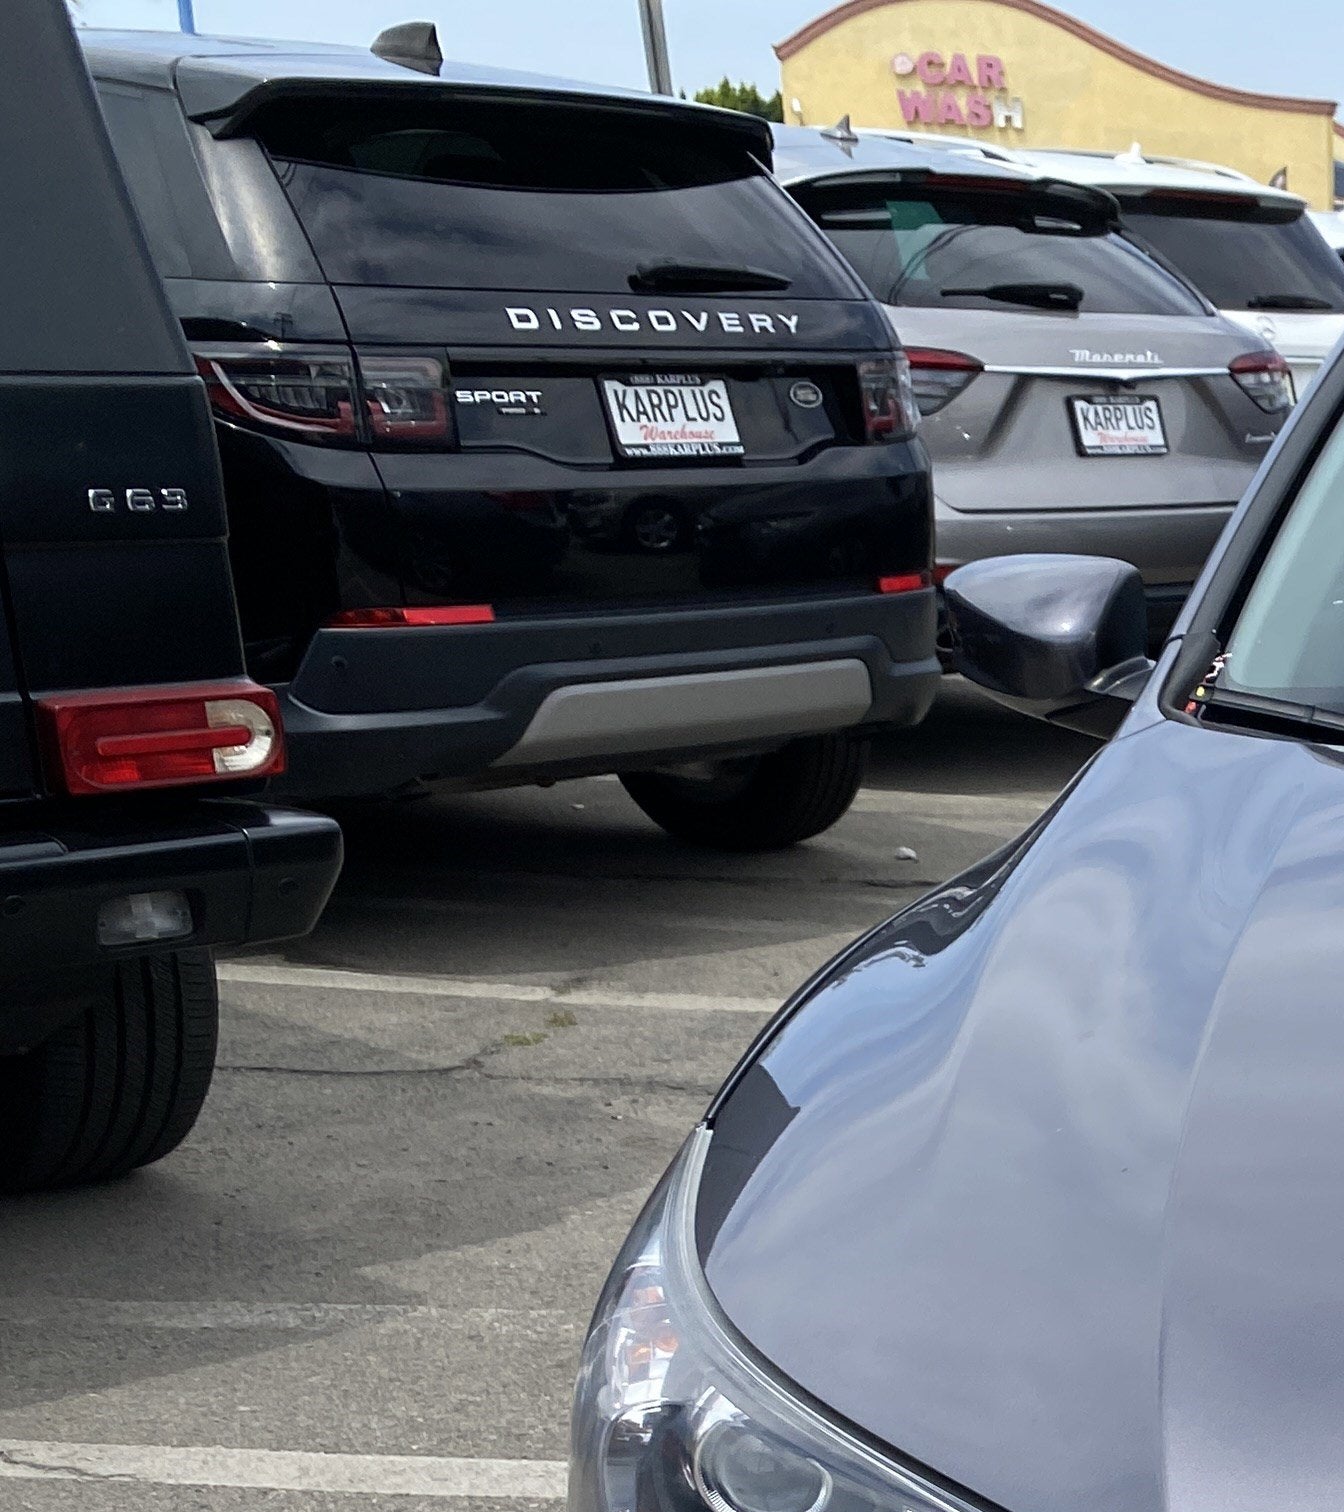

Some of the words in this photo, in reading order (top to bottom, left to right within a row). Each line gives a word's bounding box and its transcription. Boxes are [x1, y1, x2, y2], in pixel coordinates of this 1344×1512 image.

[919, 51, 1006, 88] CAR
[896, 88, 1024, 129] WASH
[505, 307, 799, 335] DISCOVERY
[1069, 349, 1164, 364] Maserati
[456, 390, 543, 403] SPORT
[613, 388, 726, 422] KARPLUS
[1080, 406, 1156, 431] KARPLUS
[639, 424, 715, 442] Warehouse
